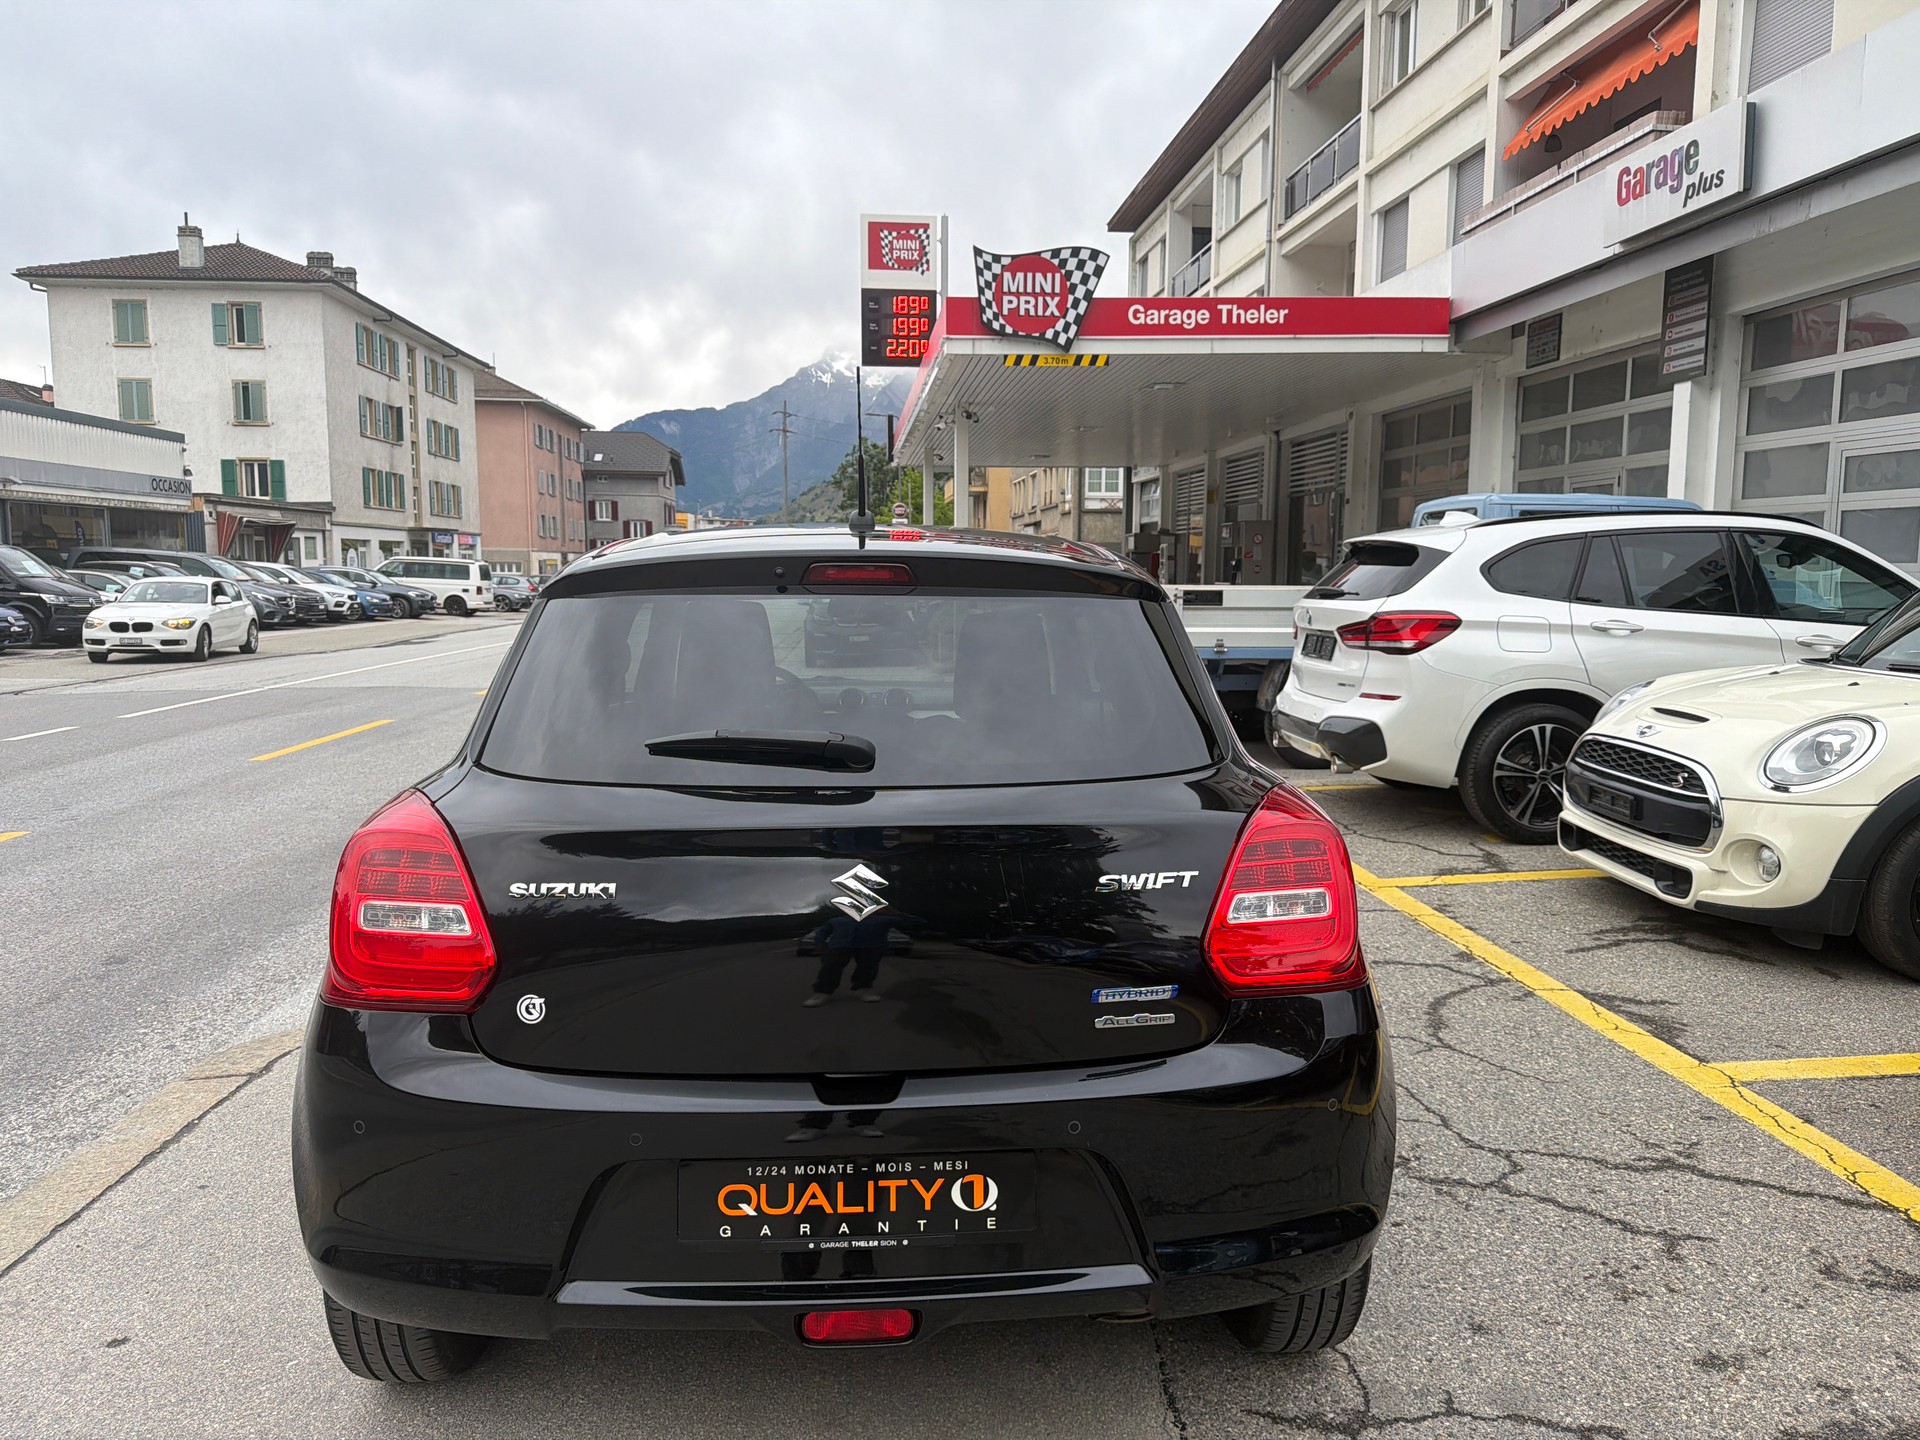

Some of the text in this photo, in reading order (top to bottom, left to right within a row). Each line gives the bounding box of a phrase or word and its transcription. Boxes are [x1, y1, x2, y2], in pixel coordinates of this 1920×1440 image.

[1617, 139, 1700, 207] Garage
[1683, 168, 1725, 208] plus
[893, 239, 920, 250] MINI
[893, 250, 920, 260] PRIX
[1002, 272, 1061, 294] MINI
[1002, 296, 1061, 317] PRIX
[1127, 304, 1289, 330] Garage Theler
[151, 478, 191, 494] OCCASION
[508, 882, 617, 900] SUZUKI
[1095, 870, 1199, 893] SWIFT
[1104, 987, 1166, 1000] HYBRID
[747, 1165, 787, 1176] 12/24
[794, 1163, 855, 1175] MONATE
[875, 1161, 913, 1172] MOIS
[933, 1160, 969, 1171] MESI
[717, 1177, 946, 1217] QUALITY
[719, 1217, 997, 1238] GARANTIE
[820, 1239, 897, 1249] GARAGE THELER SION
